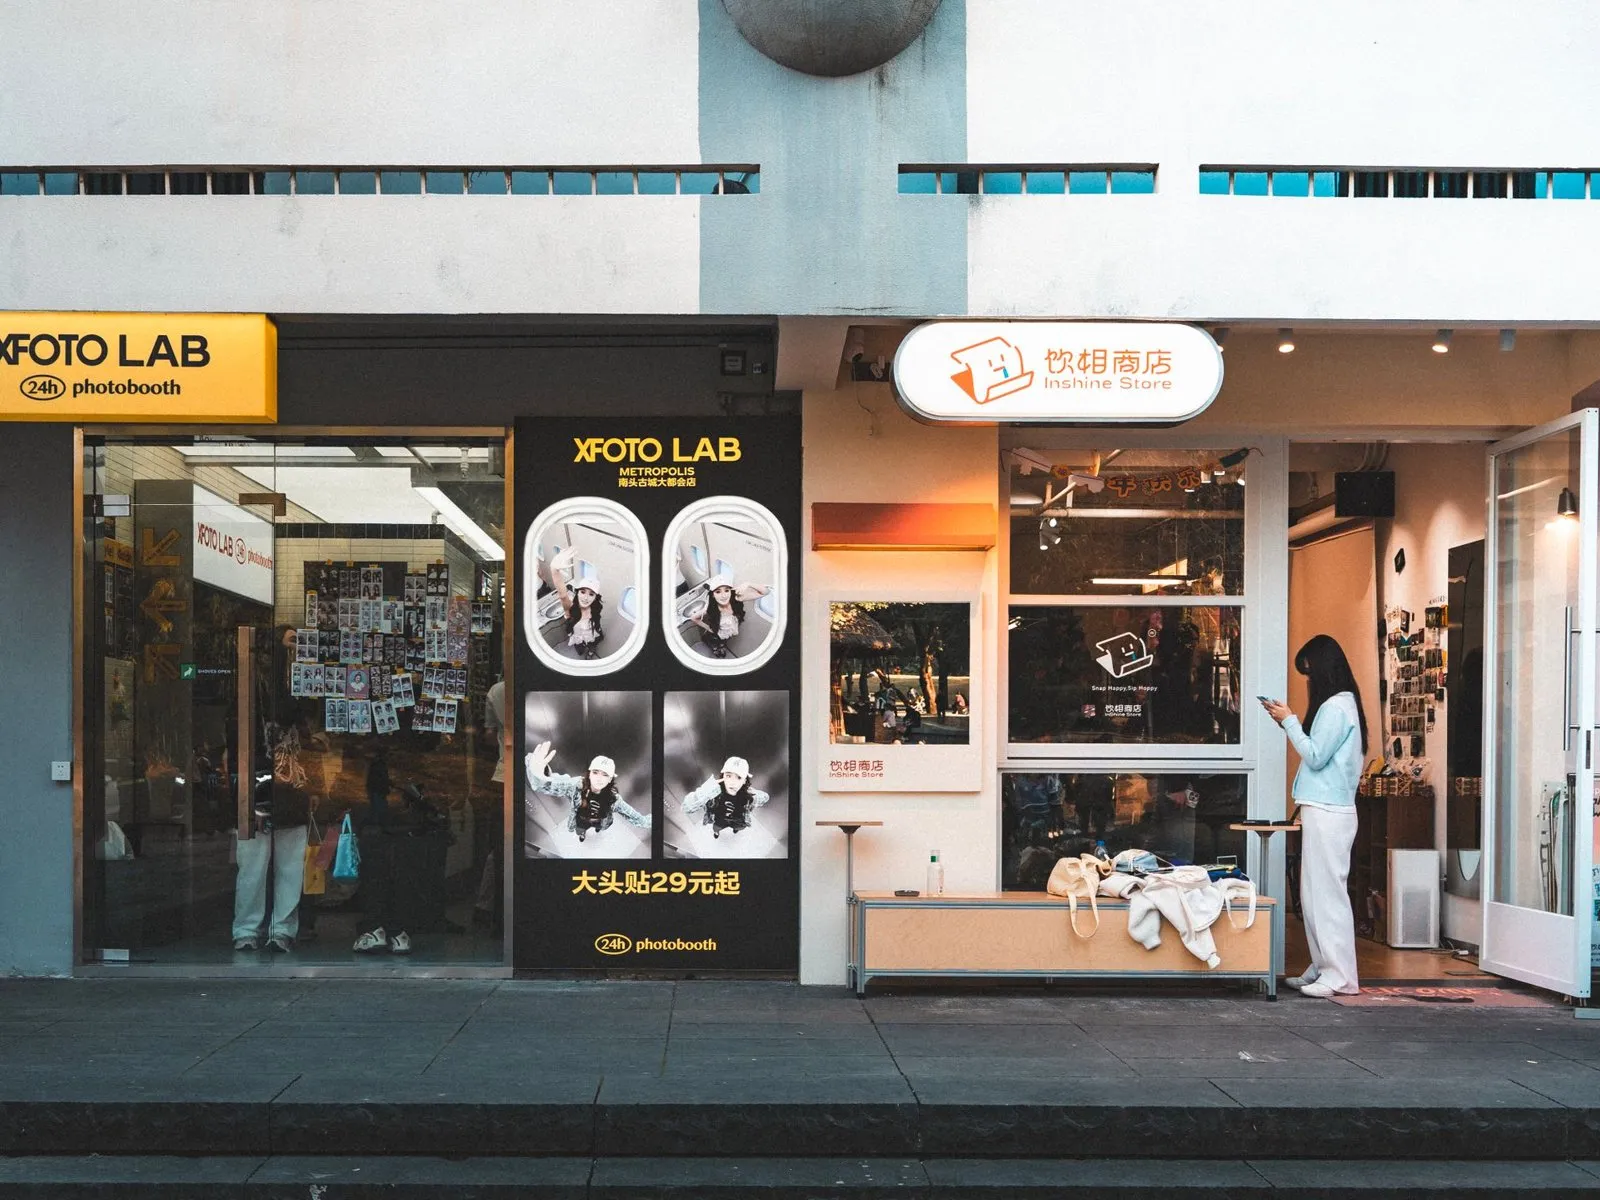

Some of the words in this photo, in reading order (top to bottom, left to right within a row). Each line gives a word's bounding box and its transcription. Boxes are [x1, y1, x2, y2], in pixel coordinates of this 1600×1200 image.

[0, 334, 108, 366] XFOTO
[119, 334, 211, 368] LAB
[1045, 348, 1172, 375] 饮相商店
[27, 379, 58, 396] 24h
[72, 379, 181, 398] photobooth
[1045, 376, 1113, 390] Inshine
[1119, 376, 1172, 390] Store
[573, 437, 663, 463] XFOTO
[672, 437, 742, 463] LAB
[619, 466, 695, 476] METROPOLIS
[618, 476, 696, 488] 南头古城大都会店
[197, 522, 218, 551] XFOTO
[218, 532, 234, 558] LAB
[830, 759, 884, 772] 饮相商店
[829, 771, 860, 779] InShine
[861, 771, 884, 779] Store
[571, 869, 741, 896] 大头贴29元起
[600, 937, 626, 951] 24h
[635, 937, 718, 954] photobooth
